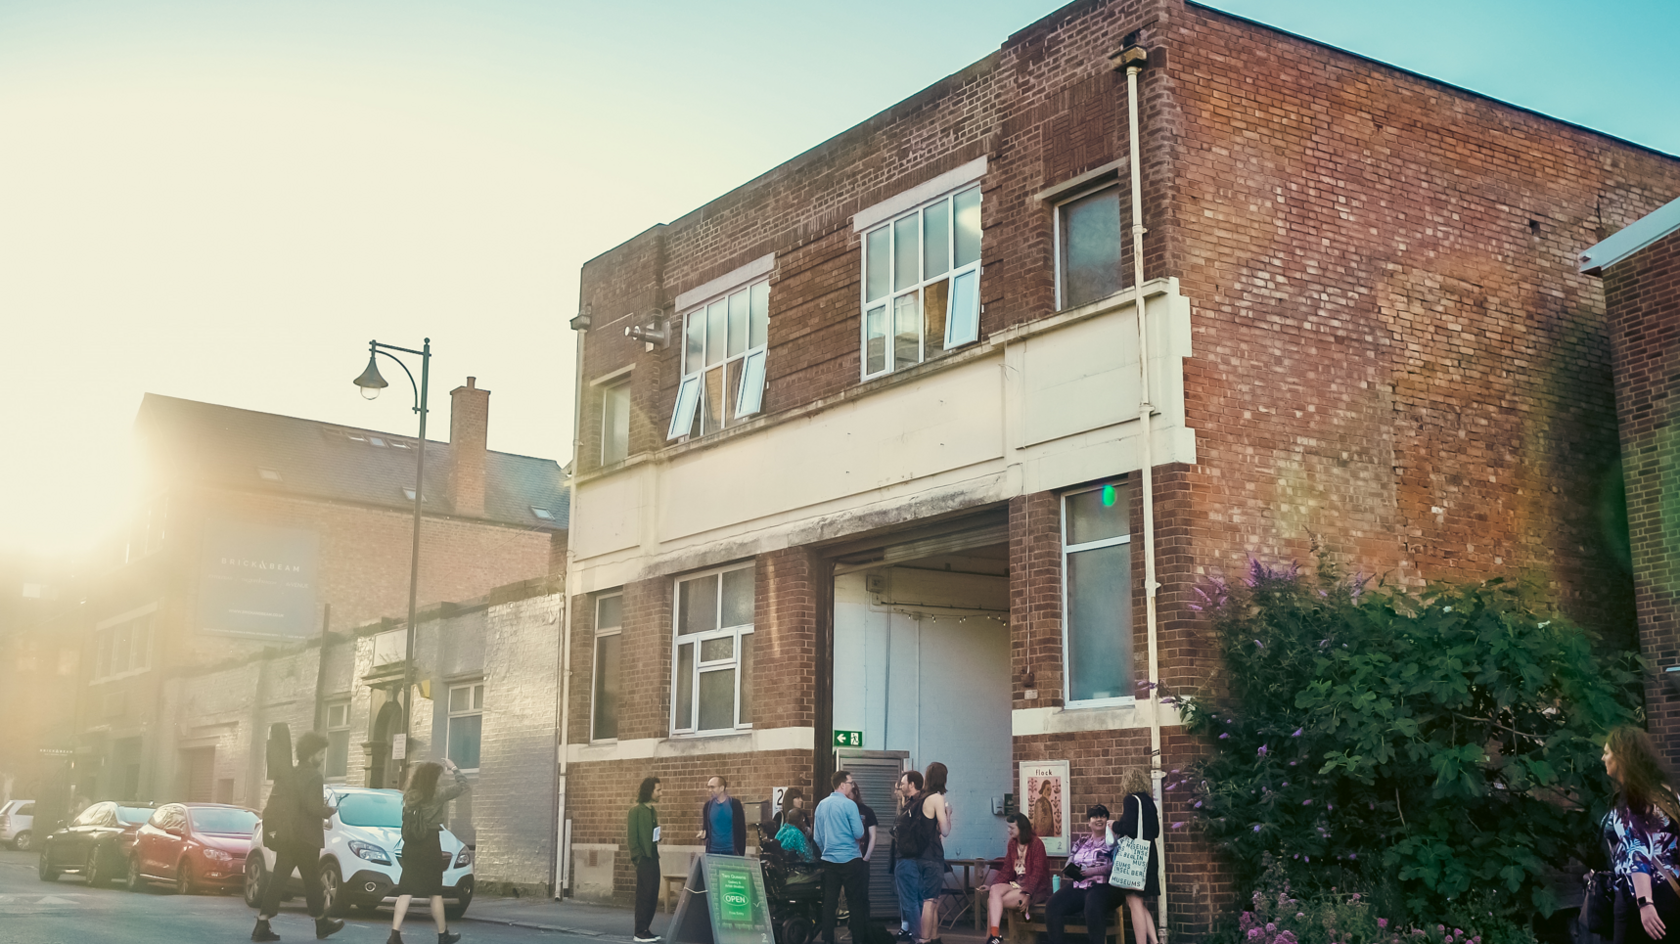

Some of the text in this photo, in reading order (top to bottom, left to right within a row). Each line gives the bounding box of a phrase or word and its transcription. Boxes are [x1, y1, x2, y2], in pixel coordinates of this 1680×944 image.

[777, 789, 783, 805] 2
[1111, 876, 1141, 887] MUSEUMS
[725, 895, 746, 903] OPEN
